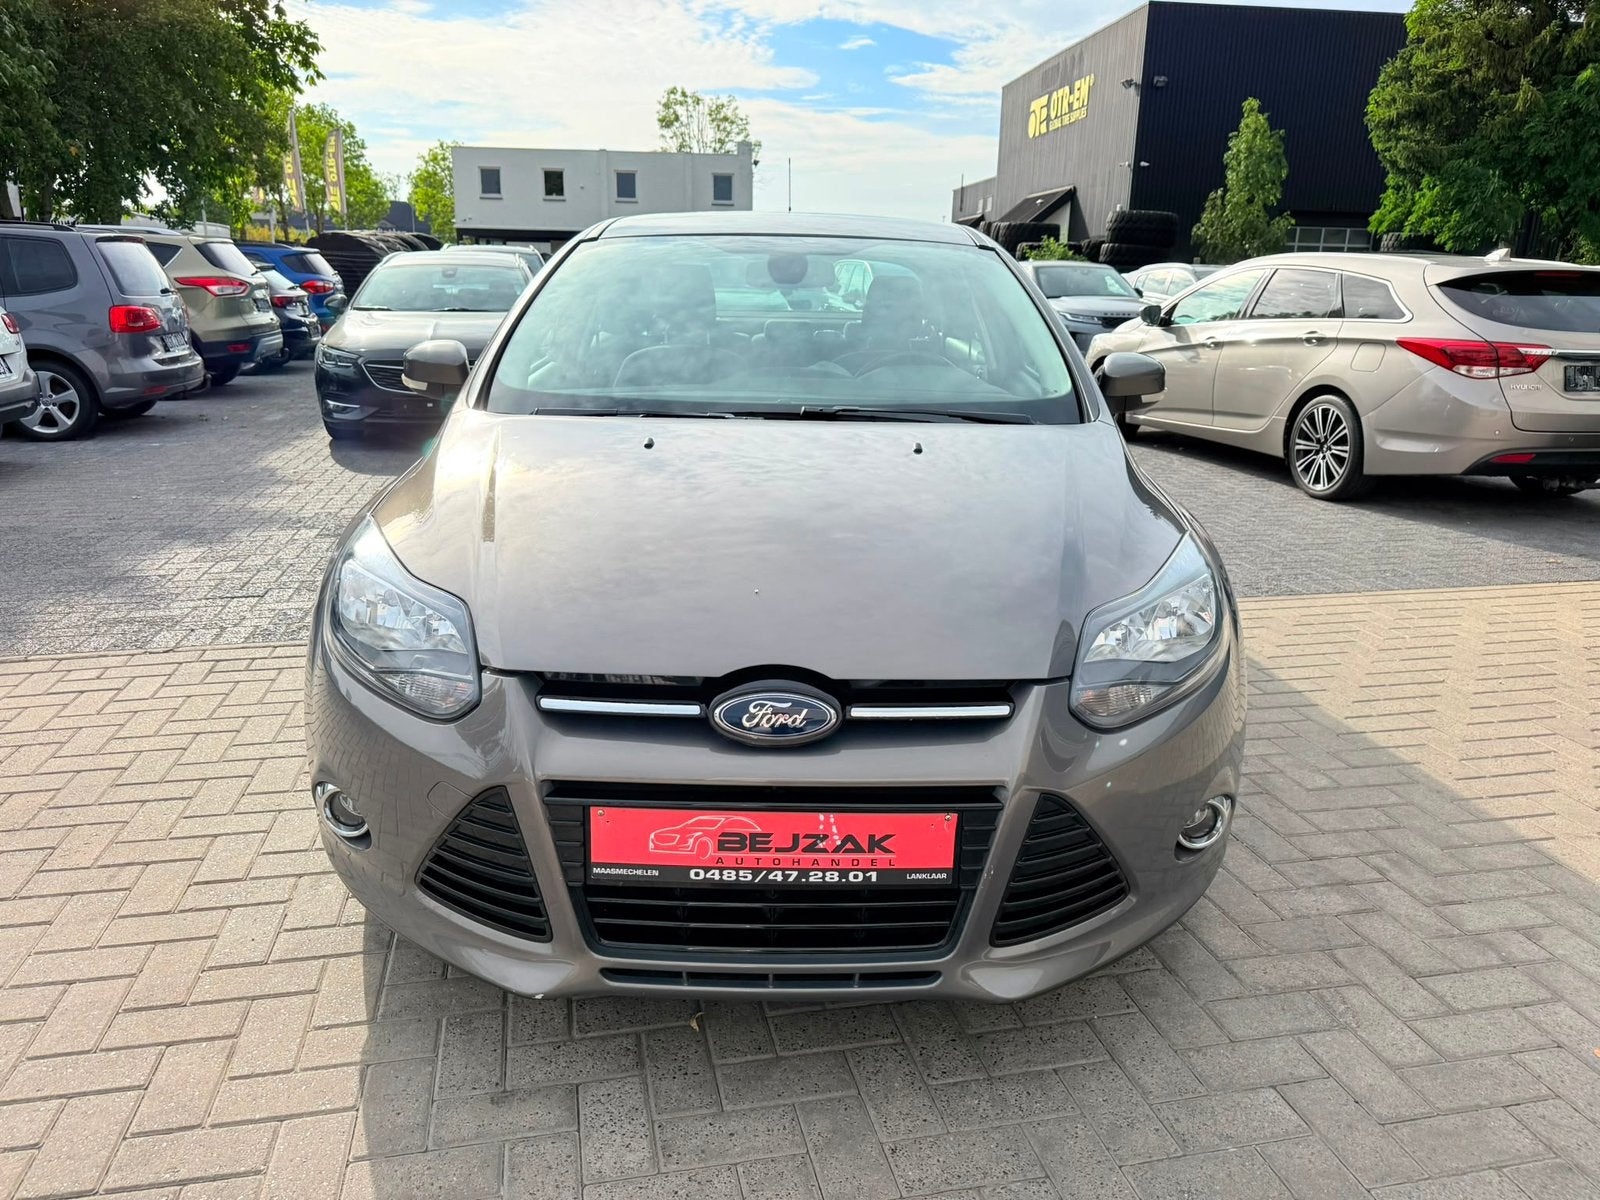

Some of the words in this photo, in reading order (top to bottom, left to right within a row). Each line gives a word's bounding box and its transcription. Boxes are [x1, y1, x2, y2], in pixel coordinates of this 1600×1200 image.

[1050, 75, 1091, 120] OTR-EM
[741, 700, 809, 728] Ford
[717, 831, 897, 854] BEJZAK
[715, 857, 896, 867] AUTOHANDEL
[592, 867, 659, 877] MAASMECHELEN
[689, 868, 878, 883] 0485/47.28.01
[906, 872, 948, 881] LANKLAAR
